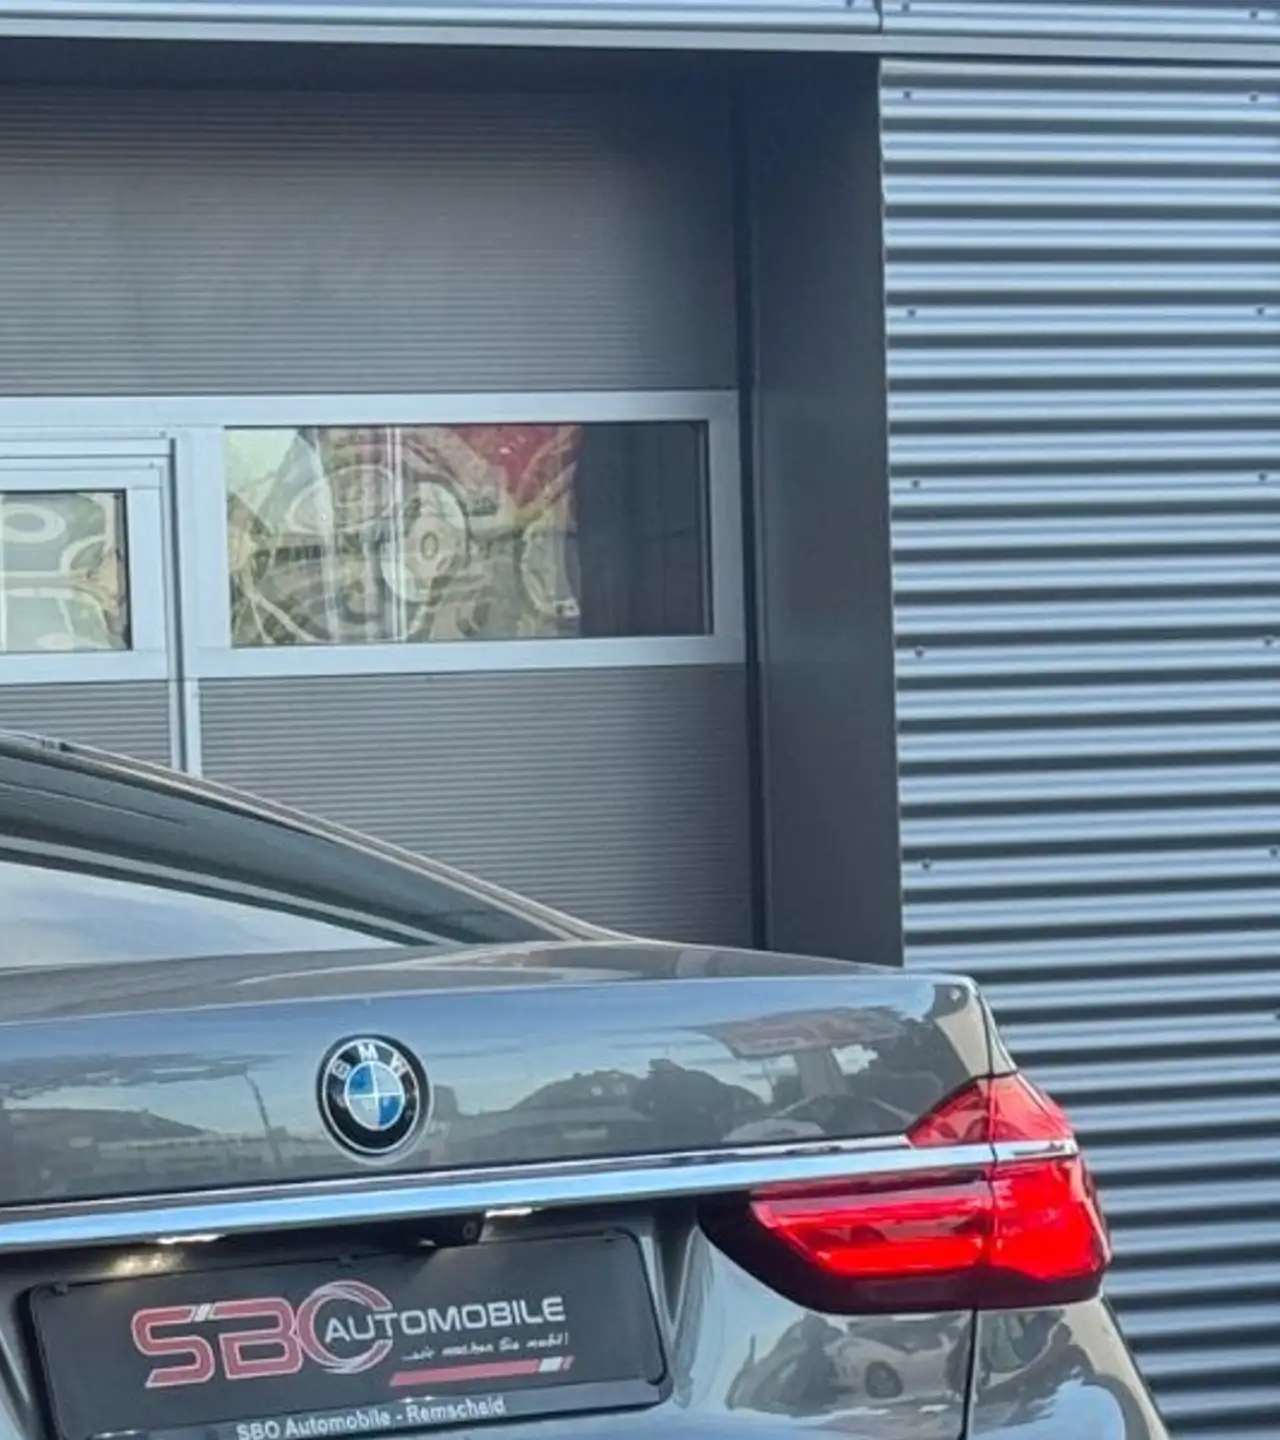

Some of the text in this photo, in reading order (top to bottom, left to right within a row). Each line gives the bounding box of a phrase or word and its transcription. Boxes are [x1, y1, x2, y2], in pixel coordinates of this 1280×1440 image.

[331, 1043, 409, 1081] BMW
[324, 1297, 567, 1343] AUTOMOBILE
[285, 1409, 391, 1439] Automobile
[406, 1395, 506, 1424] Remscheid
